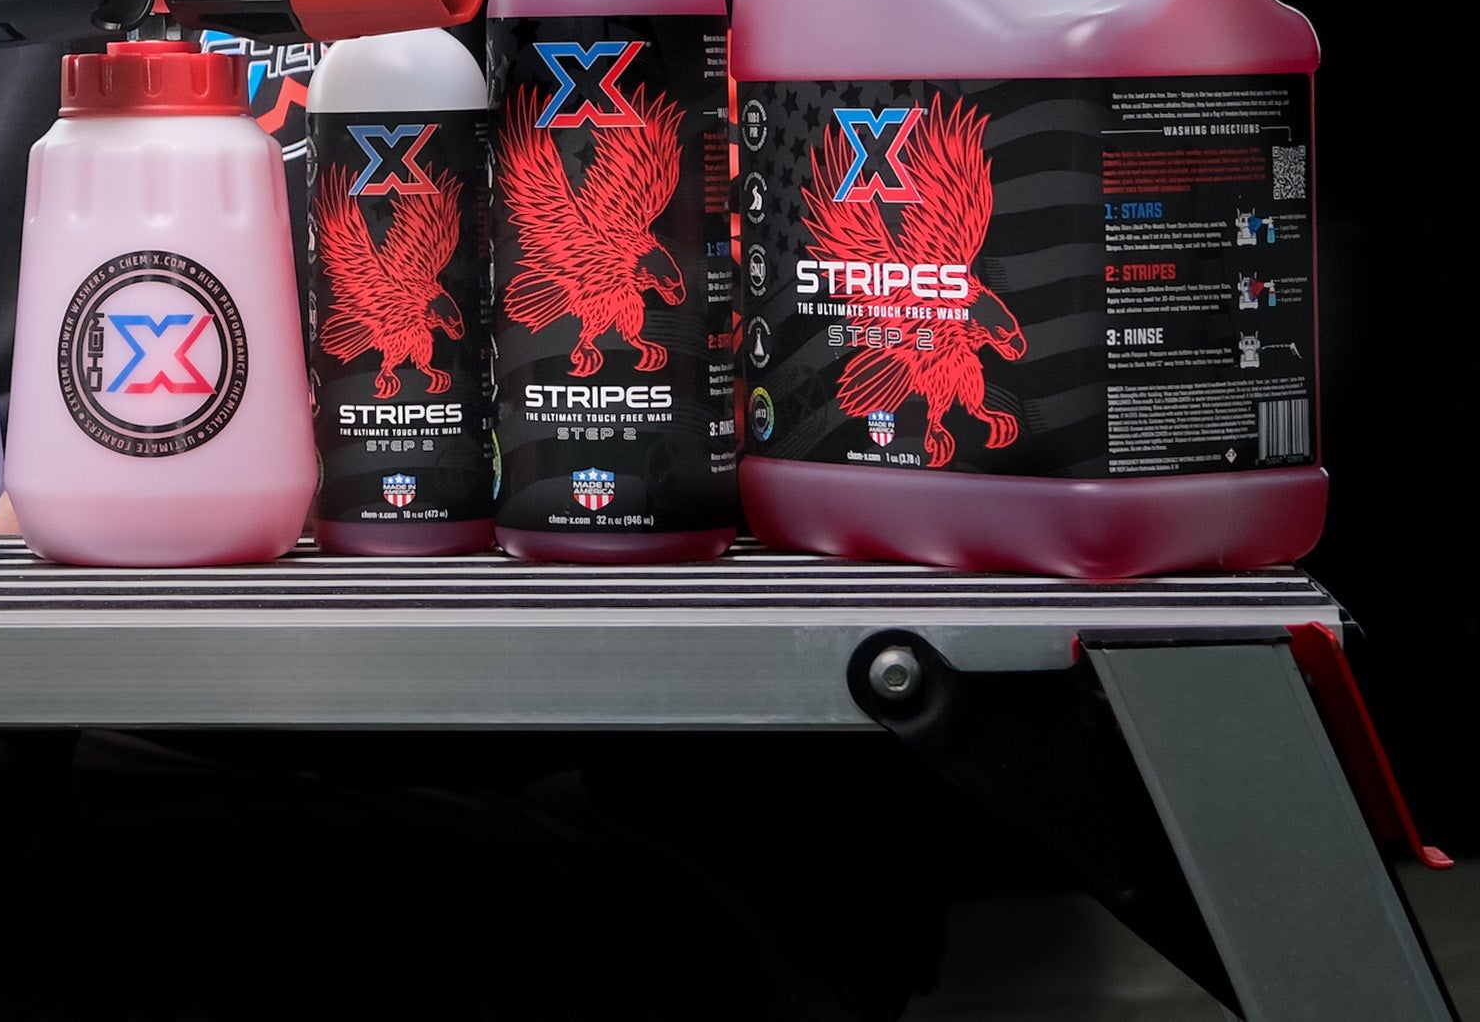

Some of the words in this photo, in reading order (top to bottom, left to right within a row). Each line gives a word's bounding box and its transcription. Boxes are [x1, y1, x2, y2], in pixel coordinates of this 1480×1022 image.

[1163, 126, 1207, 136] WASHING
[1210, 124, 1260, 135] DIRECTIONS
[1104, 203, 1118, 219] 1:
[1121, 202, 1163, 219] STARS
[119, 254, 187, 271] CHEM-X.COM
[796, 260, 969, 299] STRIPES
[1105, 265, 1120, 282] 2:
[1122, 263, 1176, 281] STRIPES
[70, 269, 106, 313] WASHERS
[197, 270, 220, 295] HIGH
[797, 302, 814, 315] THE
[817, 303, 863, 317] ULTIMATE
[868, 305, 901, 318] TOUCH
[905, 306, 932, 319] FREE
[937, 308, 969, 321] WASH
[60, 316, 75, 356] POWER
[219, 295, 246, 376] PERFORMANCE
[828, 325, 902, 348] STEP
[916, 329, 934, 350] 2
[1106, 329, 1121, 346] 3:
[1123, 327, 1164, 346] RINSE
[60, 361, 81, 412] EXTREME
[524, 384, 673, 409] STRIPES
[205, 380, 243, 434] CHEMICALS
[339, 403, 463, 425] STRIPES
[525, 412, 539, 421] THE
[541, 413, 583, 422] ULTIMATE
[586, 413, 616, 422] TOUCH
[620, 413, 644, 422] FREE
[647, 412, 673, 422] WASH
[83, 420, 131, 451] FOAMERS
[340, 428, 351, 436] THE
[353, 428, 389, 436] ULTIMATE
[392, 428, 417, 436] TOUCH
[420, 428, 439, 436] FREE
[442, 427, 461, 435] WASH
[556, 427, 615, 440] STEP
[623, 427, 637, 440] 2
[136, 434, 196, 453] ULTIMATE
[365, 440, 415, 451] STEP
[422, 439, 434, 451] 2
[548, 514, 591, 525] chem-x.com
[595, 515, 607, 525] 32
[623, 515, 642, 526] (946
